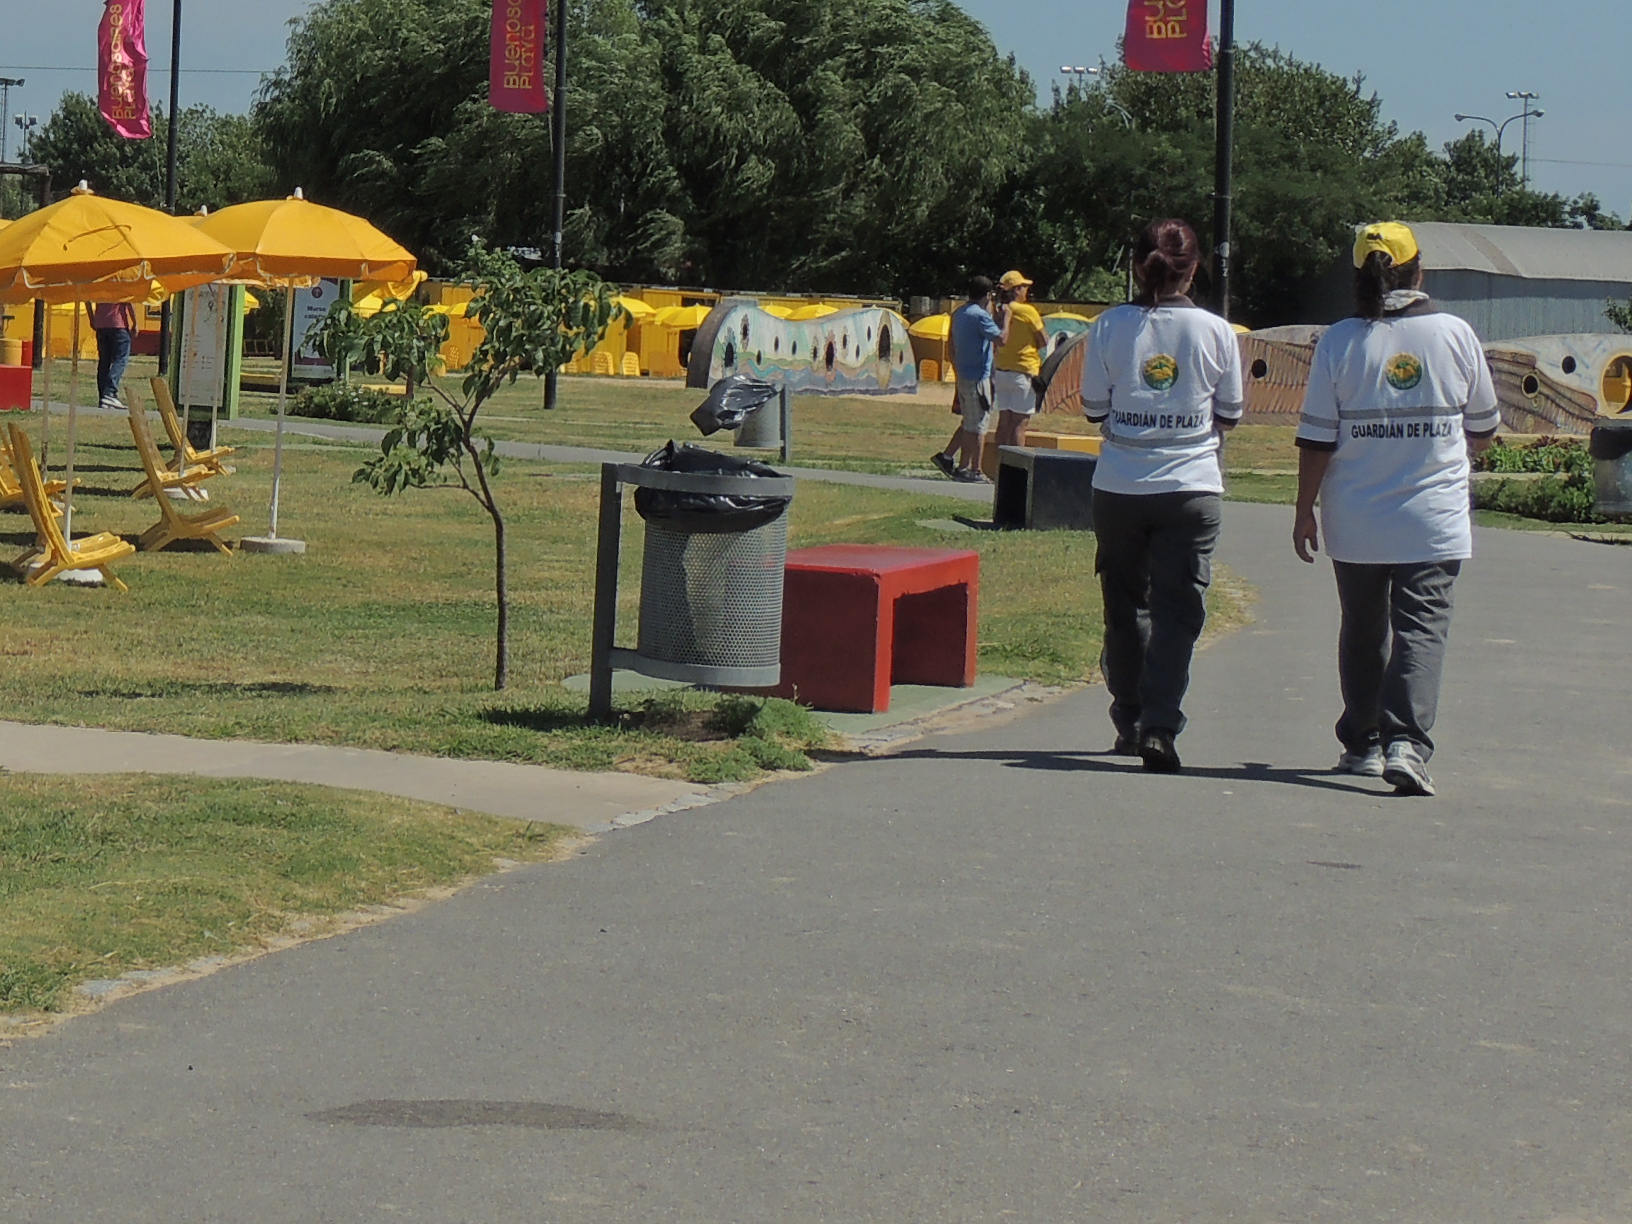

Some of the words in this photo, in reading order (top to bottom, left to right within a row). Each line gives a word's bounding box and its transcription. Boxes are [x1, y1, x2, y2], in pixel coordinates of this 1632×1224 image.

[1159, 415, 1173, 429] DE
[1175, 414, 1204, 428] PLAZA
[1351, 420, 1404, 439] GUARDIÁN
[1406, 422, 1420, 438] DE
[1423, 422, 1452, 437] PLAZA
